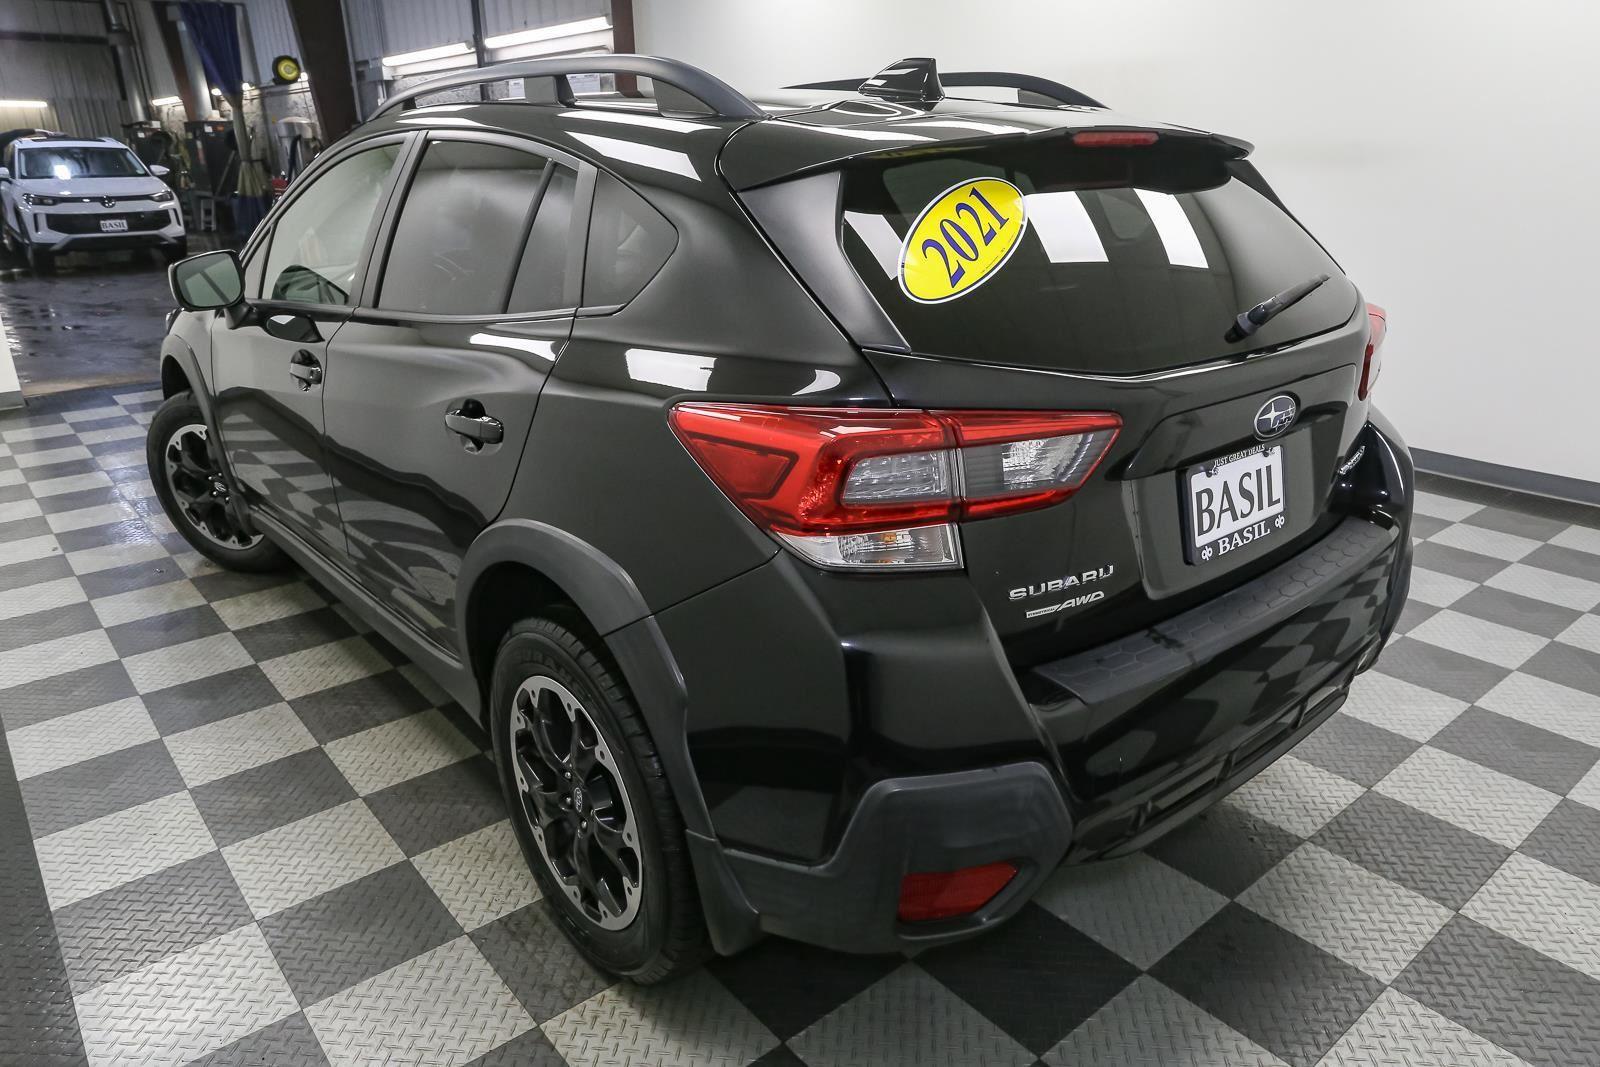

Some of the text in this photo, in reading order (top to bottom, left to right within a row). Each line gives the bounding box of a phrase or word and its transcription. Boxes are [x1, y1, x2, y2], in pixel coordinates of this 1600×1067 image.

[101, 221, 126, 230] BASIL
[921, 186, 1010, 289] 2021
[1214, 443, 1265, 468] JUST GREAT DEALS
[1195, 464, 1281, 537] BASIL
[1217, 520, 1271, 556] BASIL
[1008, 564, 1114, 600] SUBARU
[1056, 590, 1105, 612] AWD
